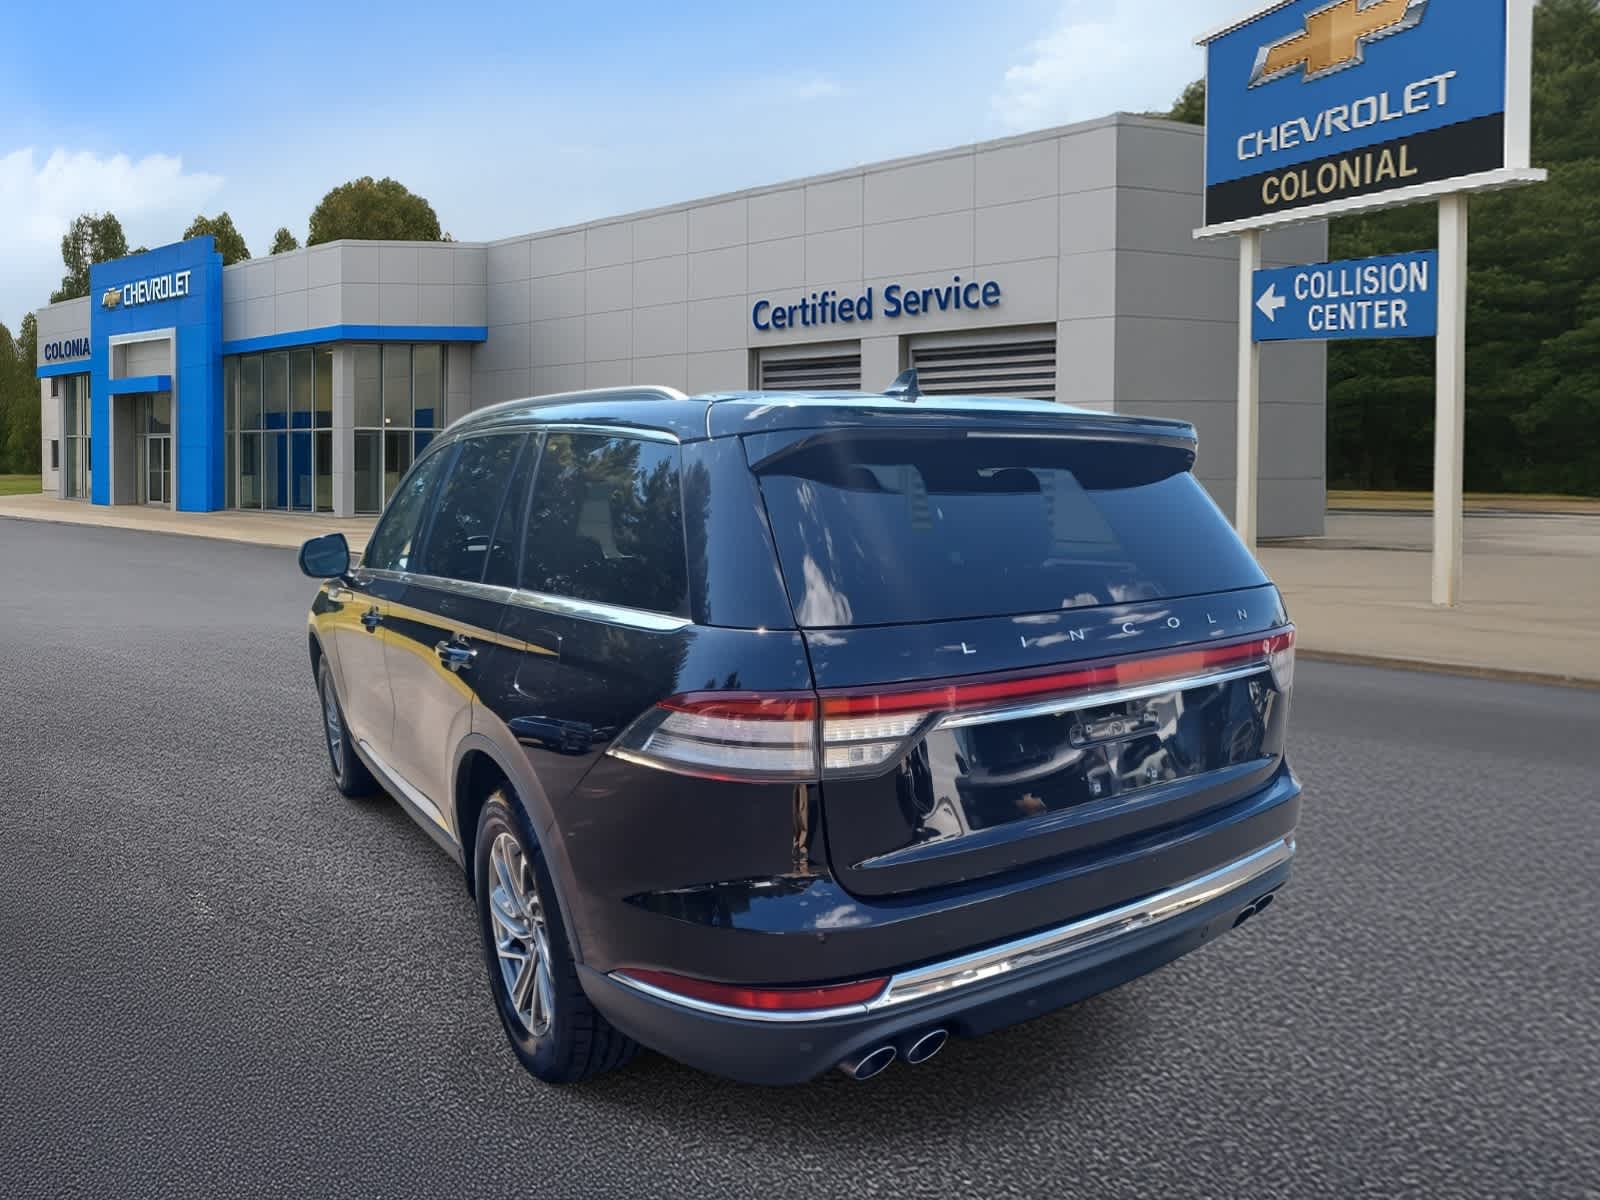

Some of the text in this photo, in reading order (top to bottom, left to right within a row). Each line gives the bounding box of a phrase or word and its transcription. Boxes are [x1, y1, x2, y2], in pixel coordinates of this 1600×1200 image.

[1236, 70, 1457, 161] CHEVROLET
[1262, 144, 1418, 205] COLONIAL
[123, 270, 191, 306] CHEVROLET
[752, 275, 1001, 330] Certified Service
[1294, 260, 1428, 300] COLLISION
[1308, 299, 1408, 332] CENTER
[961, 608, 1249, 655] LINCOLN
